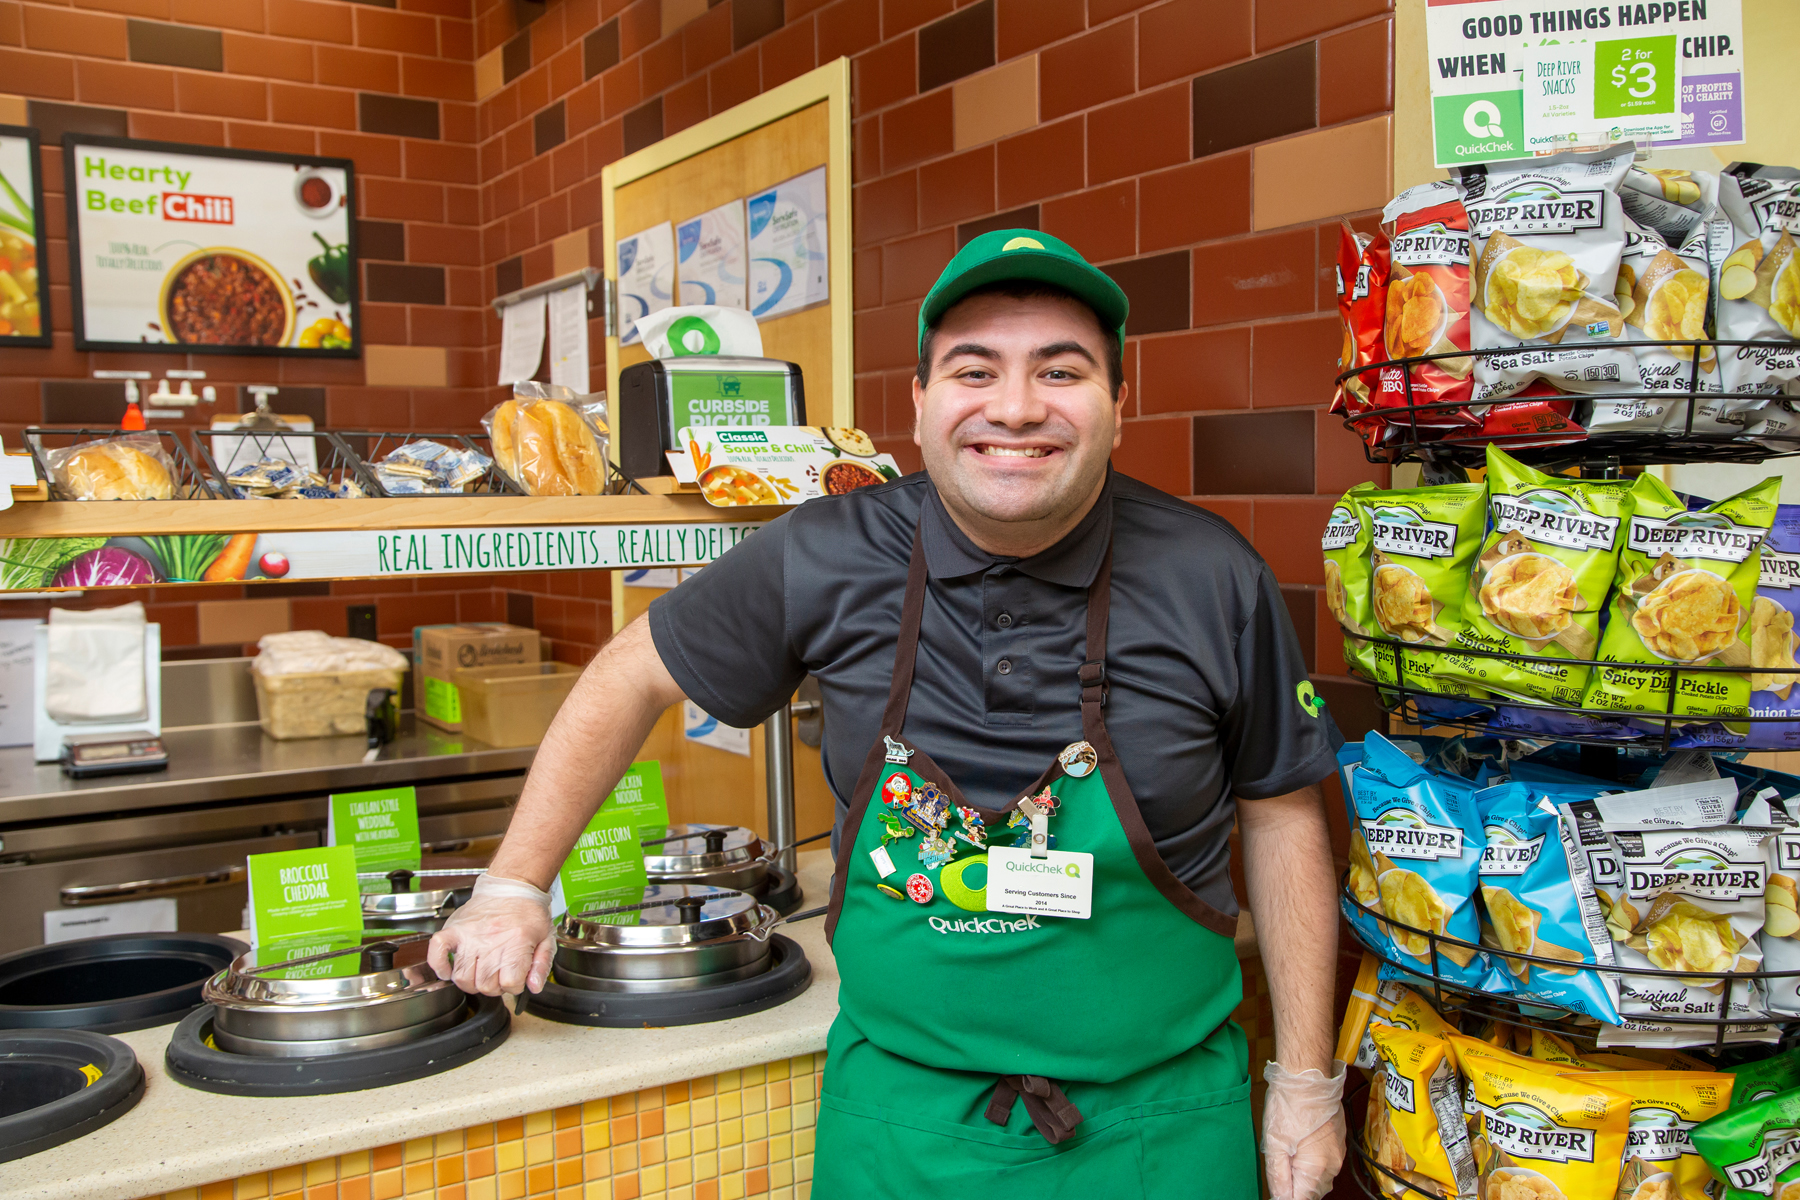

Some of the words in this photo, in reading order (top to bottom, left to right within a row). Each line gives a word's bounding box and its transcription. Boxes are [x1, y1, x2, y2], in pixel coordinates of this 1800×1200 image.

[1462, 15, 1523, 39] GOOD
[1530, 7, 1611, 33] THINGS
[1618, 0, 1707, 26] HAPPEN
[1437, 53, 1506, 79] WHEN
[1683, 35, 1734, 58] CHIP.
[1621, 49, 1632, 61] 2
[1635, 49, 1653, 60] for
[1537, 62, 1555, 77] DEEP
[1557, 60, 1582, 75] RIVER
[1542, 77, 1576, 96] SNACKS
[1611, 62, 1656, 98] $3
[1682, 85, 1694, 94] OF
[1696, 82, 1733, 93] PROFITS
[1682, 94, 1694, 103] TO
[1696, 91, 1733, 102] CHARITY
[1713, 119, 1723, 127] GF
[1455, 140, 1514, 156] QuickChek
[84, 156, 191, 192] Hearty
[1490, 175, 1520, 193] Because
[86, 189, 158, 215] Beef
[165, 194, 231, 222] Chili
[1467, 206, 1519, 227] DEEP
[1520, 199, 1596, 220] RIVER
[1486, 222, 1563, 232] SNACKS
[1413, 237, 1470, 257] RIVER
[1490, 358, 1519, 372] Sea
[1521, 351, 1556, 367] Salt
[1765, 358, 1796, 371] Sea
[1602, 364, 1618, 377] 300
[1382, 380, 1405, 395] BBQ
[1643, 377, 1670, 390] Sea
[1672, 377, 1706, 392] Sat
[1736, 382, 1753, 393] NET
[688, 399, 770, 414] CURBSIDE
[1615, 403, 1634, 411] NET
[719, 432, 766, 442] Classic
[722, 444, 769, 455] Soups
[770, 444, 781, 453] &
[783, 443, 816, 454] Chili
[1494, 501, 1541, 525] DEEP
[1540, 512, 1610, 542] RIVER
[1391, 525, 1449, 549] RIVER
[1505, 523, 1578, 543] SNACKS
[1633, 523, 1689, 543] DEEP
[1690, 528, 1763, 552] RIVER
[378, 534, 433, 572] REAL
[441, 529, 608, 569] INGREDIENTS.
[617, 528, 687, 564] REALLY
[1657, 546, 1735, 556] SNACKS
[1455, 632, 1494, 654] Spicy
[1373, 647, 1395, 665] Spicy
[1522, 666, 1538, 676] Cooked
[1553, 675, 1567, 683] Chips
[1603, 668, 1647, 690] Spicy
[1680, 678, 1729, 695] Pickle
[1555, 687, 1568, 698] 140
[1611, 693, 1627, 703] WT.
[1596, 697, 1609, 707] OZ
[1609, 701, 1632, 711] (56g)
[1748, 706, 1788, 718] Onion
[615, 788, 643, 805] NOODLE
[1371, 798, 1392, 814] Because
[1401, 796, 1414, 805] Give
[1490, 814, 1504, 822] Give
[1653, 817, 1670, 825] Give
[607, 825, 632, 844] CORN
[1395, 829, 1456, 850] RIVER
[579, 844, 620, 866] CHOWDER
[1372, 845, 1428, 855] SNACKS
[1483, 843, 1540, 861] RIVER
[1654, 839, 1683, 857] Because
[1694, 837, 1713, 845] Give
[1717, 842, 1736, 858] Chip!
[279, 863, 330, 885] BROCCOLI
[1005, 861, 1063, 875] QuickChek
[1630, 871, 1690, 890] DEEP
[1690, 870, 1760, 889] RIVER
[283, 881, 330, 904] CHEDDAR
[1004, 888, 1027, 897] Serving
[1027, 890, 1059, 898] Customers
[1060, 892, 1077, 900] Since
[1656, 885, 1730, 896] SNACKS
[928, 914, 1041, 934] QuickChek
[1650, 1001, 1680, 1013] Sea
[1683, 1001, 1716, 1014] Salt
[1624, 1022, 1637, 1030] OZ
[1386, 1072, 1409, 1104] RIVER
[1493, 1091, 1519, 1102] Because
[1531, 1094, 1547, 1107] Give
[1551, 1106, 1566, 1122] Chip!
[1670, 1101, 1688, 1115] Chip!
[1775, 1117, 1790, 1125] Give
[1489, 1135, 1557, 1155] SNACKS
[1518, 1127, 1587, 1152] RIVER
